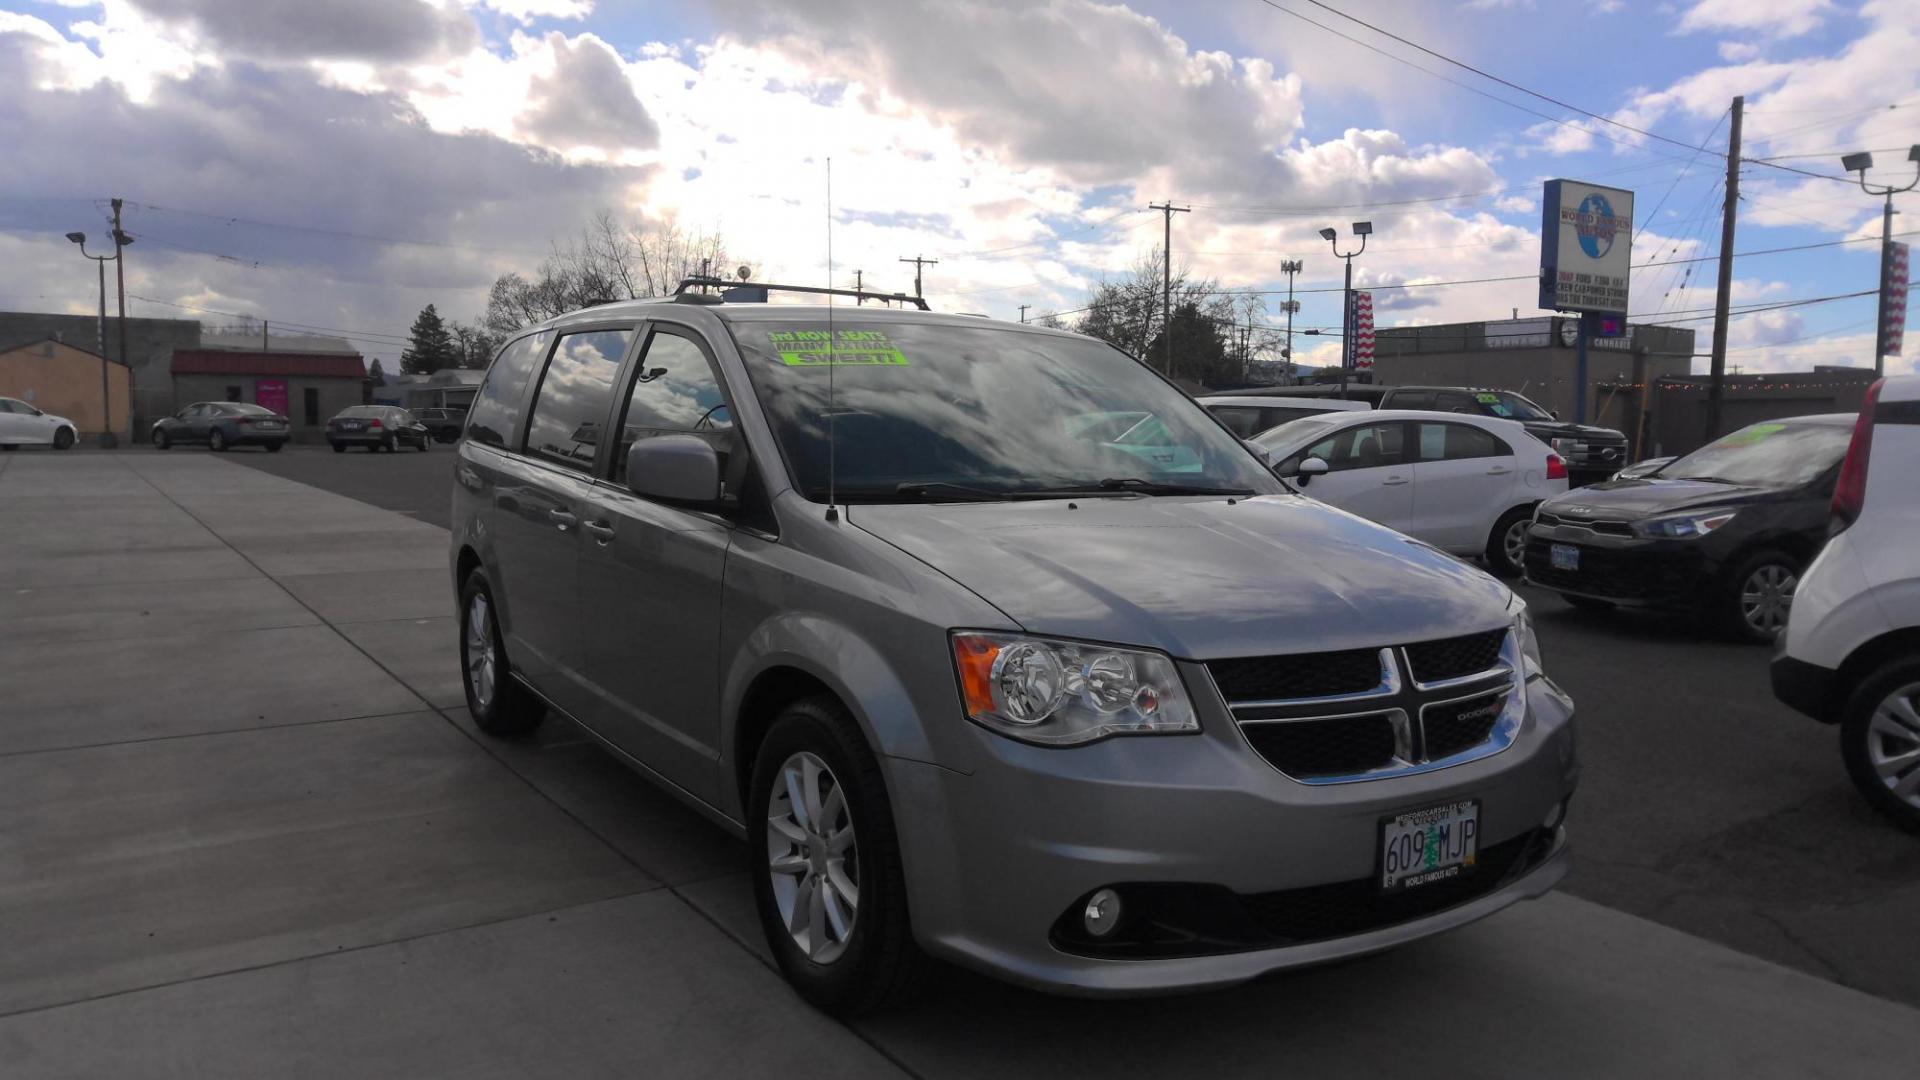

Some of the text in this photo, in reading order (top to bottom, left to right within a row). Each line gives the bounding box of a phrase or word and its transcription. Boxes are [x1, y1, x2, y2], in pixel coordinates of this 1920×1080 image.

[1561, 210, 1594, 224] WORLD
[767, 330, 888, 341] 3rd ROW SEATS
[776, 341, 898, 351] MANY EXTRAS
[1386, 819, 1476, 874] 609 MJP
[1405, 876, 1424, 887] WORLD
[1425, 870, 1445, 882] FAMOUS
